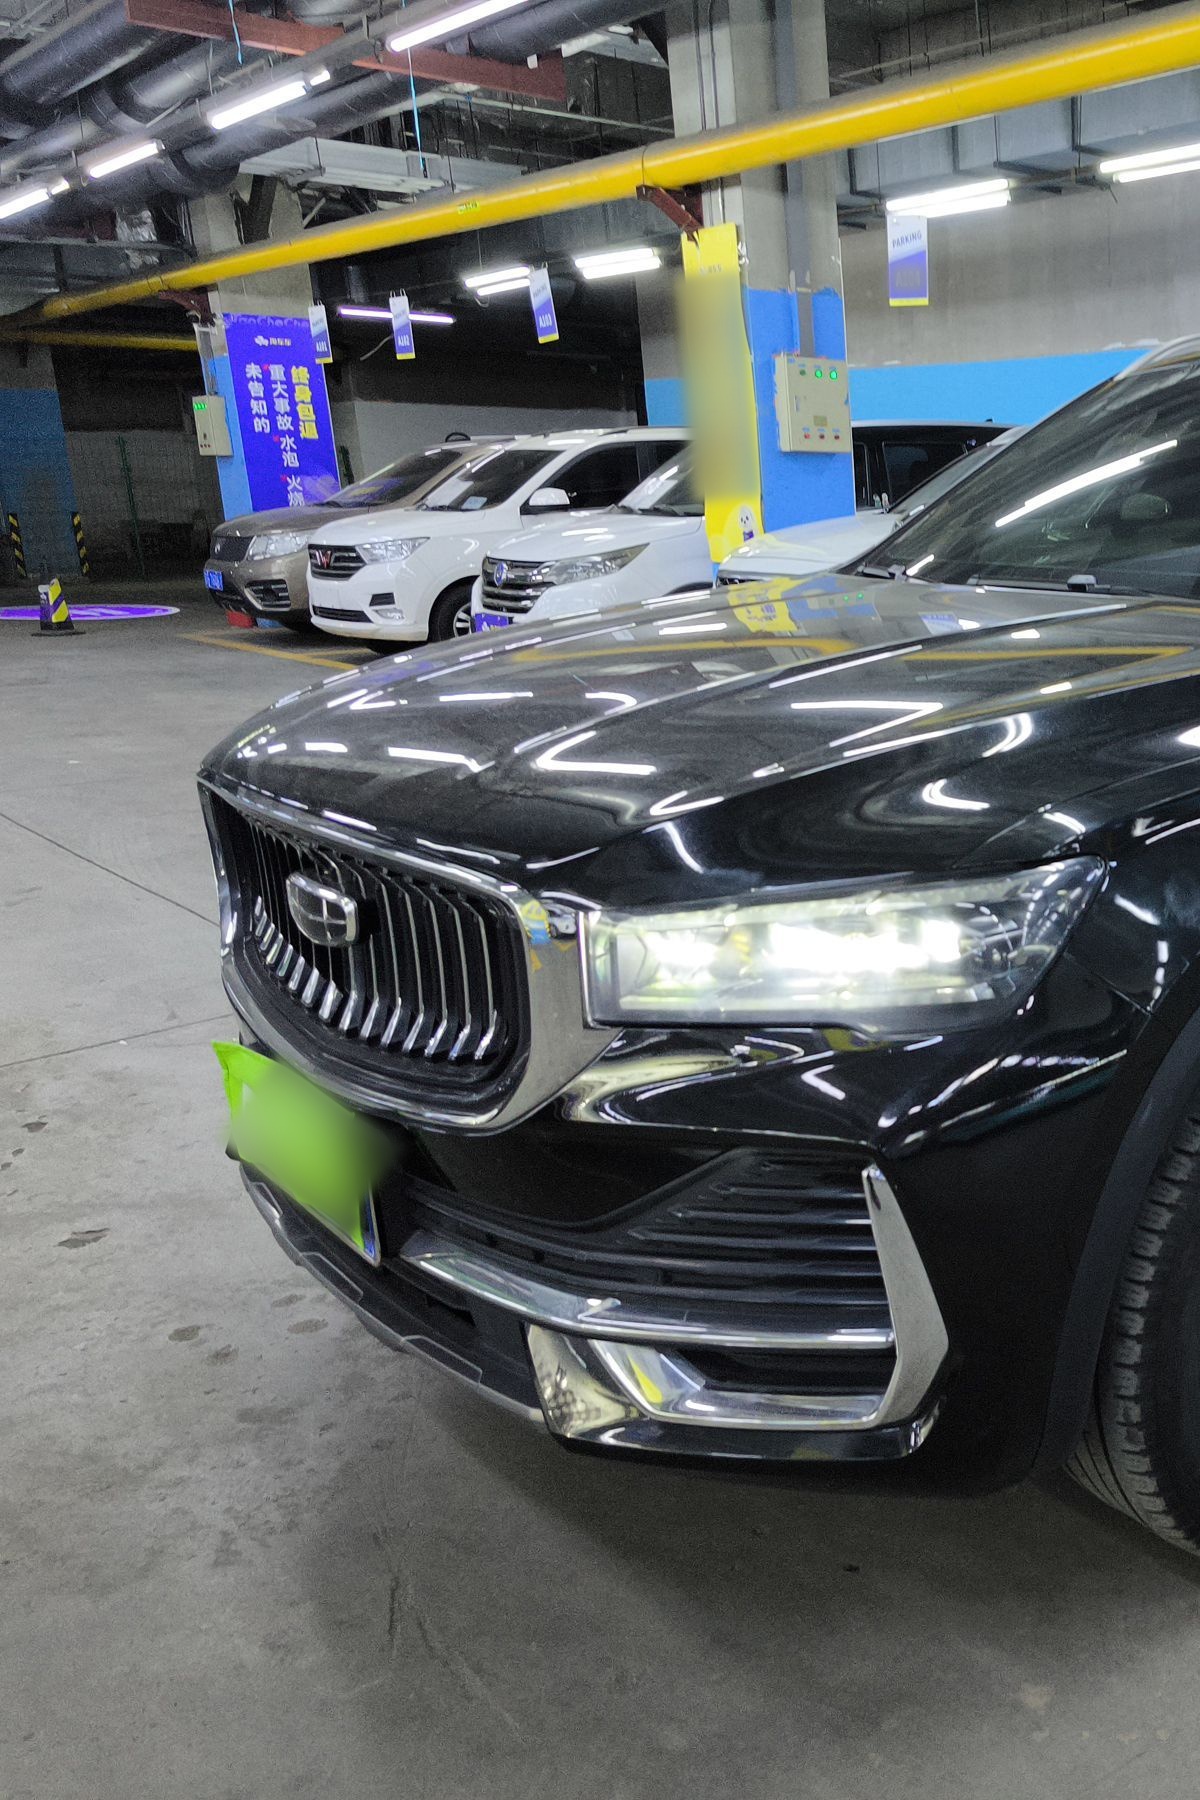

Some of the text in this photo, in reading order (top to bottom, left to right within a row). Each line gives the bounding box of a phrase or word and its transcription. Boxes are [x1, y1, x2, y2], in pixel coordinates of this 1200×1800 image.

[891, 230, 922, 249] PARKING
[245, 362, 271, 434] 未告知的
[269, 364, 295, 432] 重大事故
